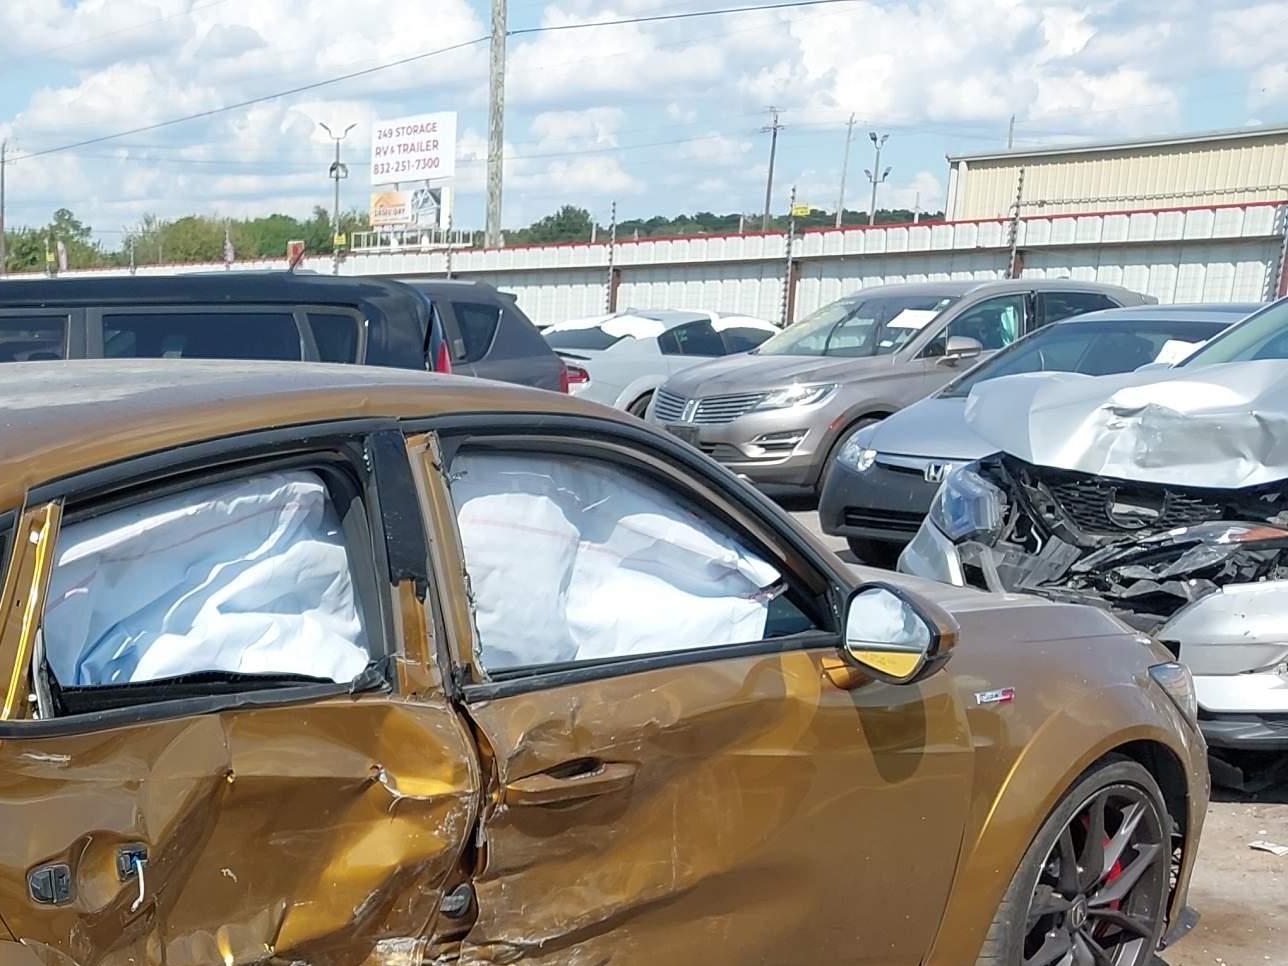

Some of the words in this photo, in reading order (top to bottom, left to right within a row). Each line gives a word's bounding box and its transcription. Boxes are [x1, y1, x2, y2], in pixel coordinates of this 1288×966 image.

[377, 128, 393, 140] 249
[395, 122, 437, 137] STORAGE
[375, 145, 389, 157] RV
[397, 139, 439, 155] TRAILER
[373, 157, 440, 175] 832-251-7300
